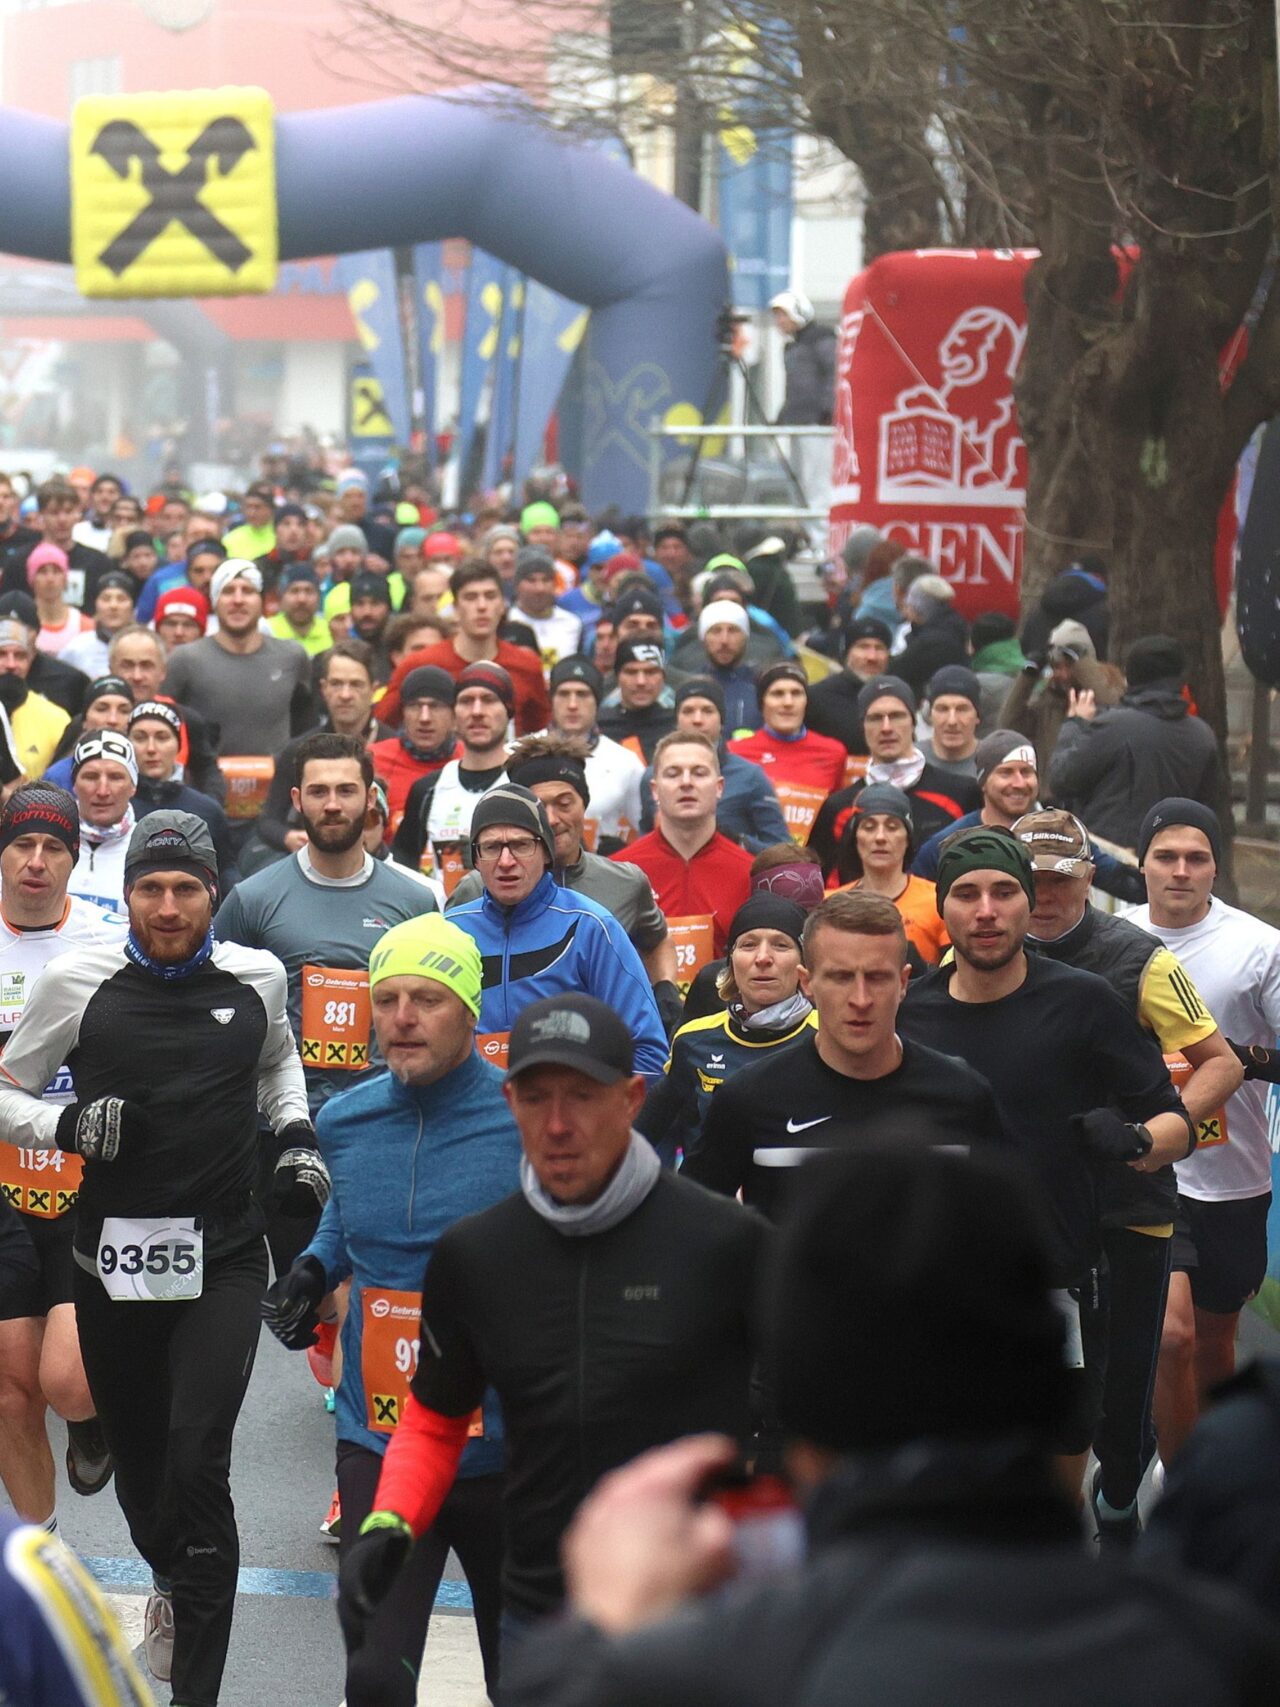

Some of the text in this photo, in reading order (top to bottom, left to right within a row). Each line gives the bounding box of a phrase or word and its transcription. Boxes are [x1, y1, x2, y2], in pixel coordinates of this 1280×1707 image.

[323, 1000, 356, 1026] 881
[17, 1147, 66, 1173] 1134
[100, 1244, 196, 1275] 9355
